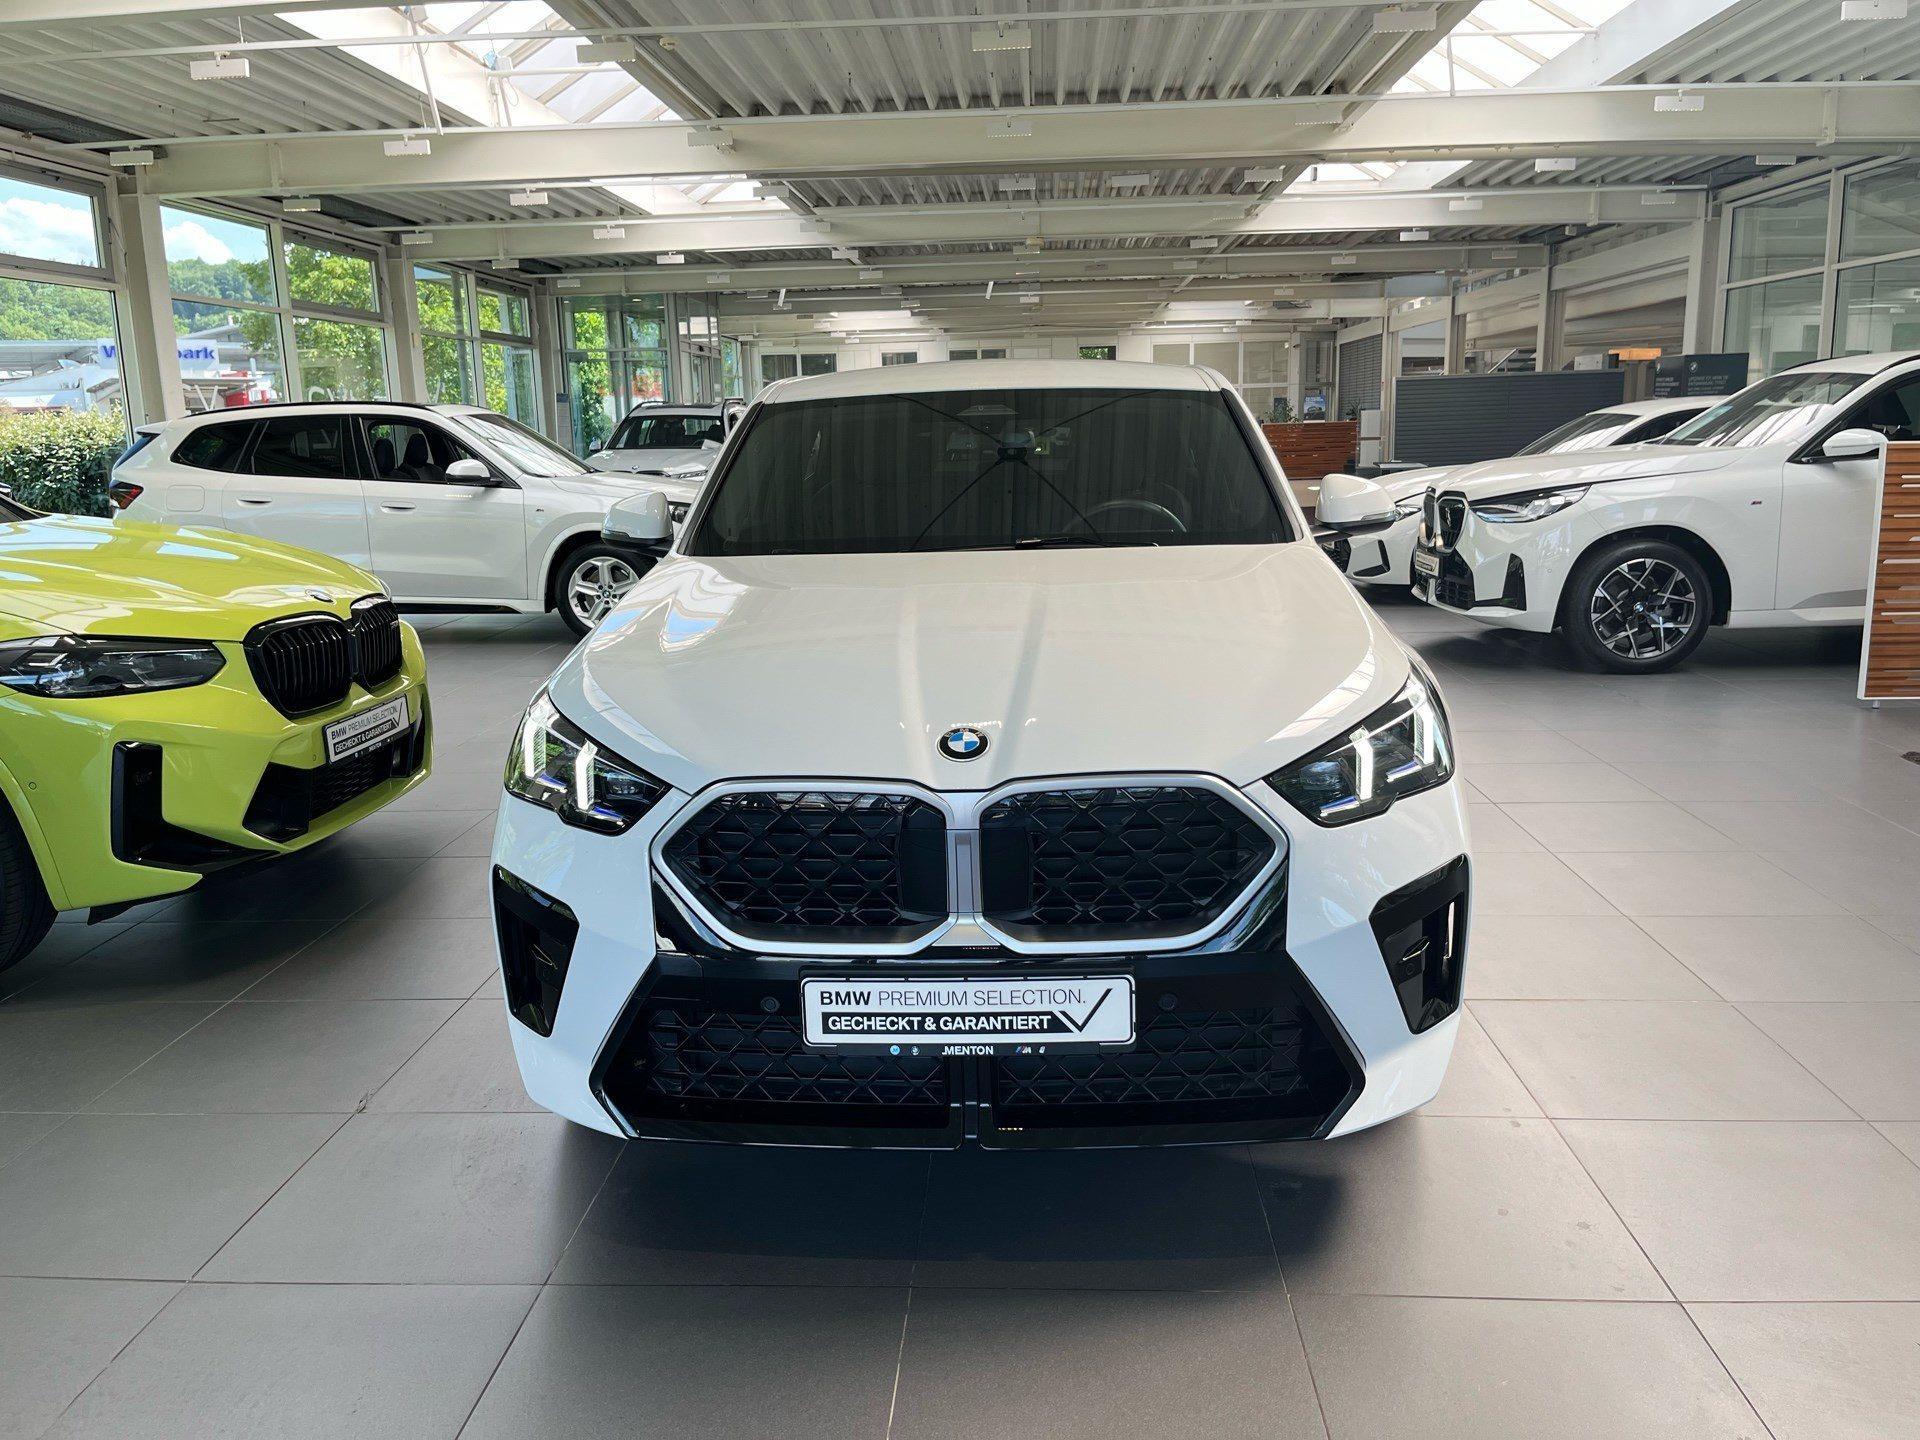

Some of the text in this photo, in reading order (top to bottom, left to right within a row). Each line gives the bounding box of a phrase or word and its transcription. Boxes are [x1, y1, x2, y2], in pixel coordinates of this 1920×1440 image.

[331, 726, 347, 740] BMW
[348, 716, 372, 731] PREMIUM
[335, 734, 362, 752] GECHECKT
[366, 721, 392, 739] GARANTIERT
[820, 988, 1086, 1005] BMW PREMIUM SELECTION.
[828, 1015, 1052, 1031] GECHECKT & GARANTIERT
[942, 1045, 994, 1055] MENTON
